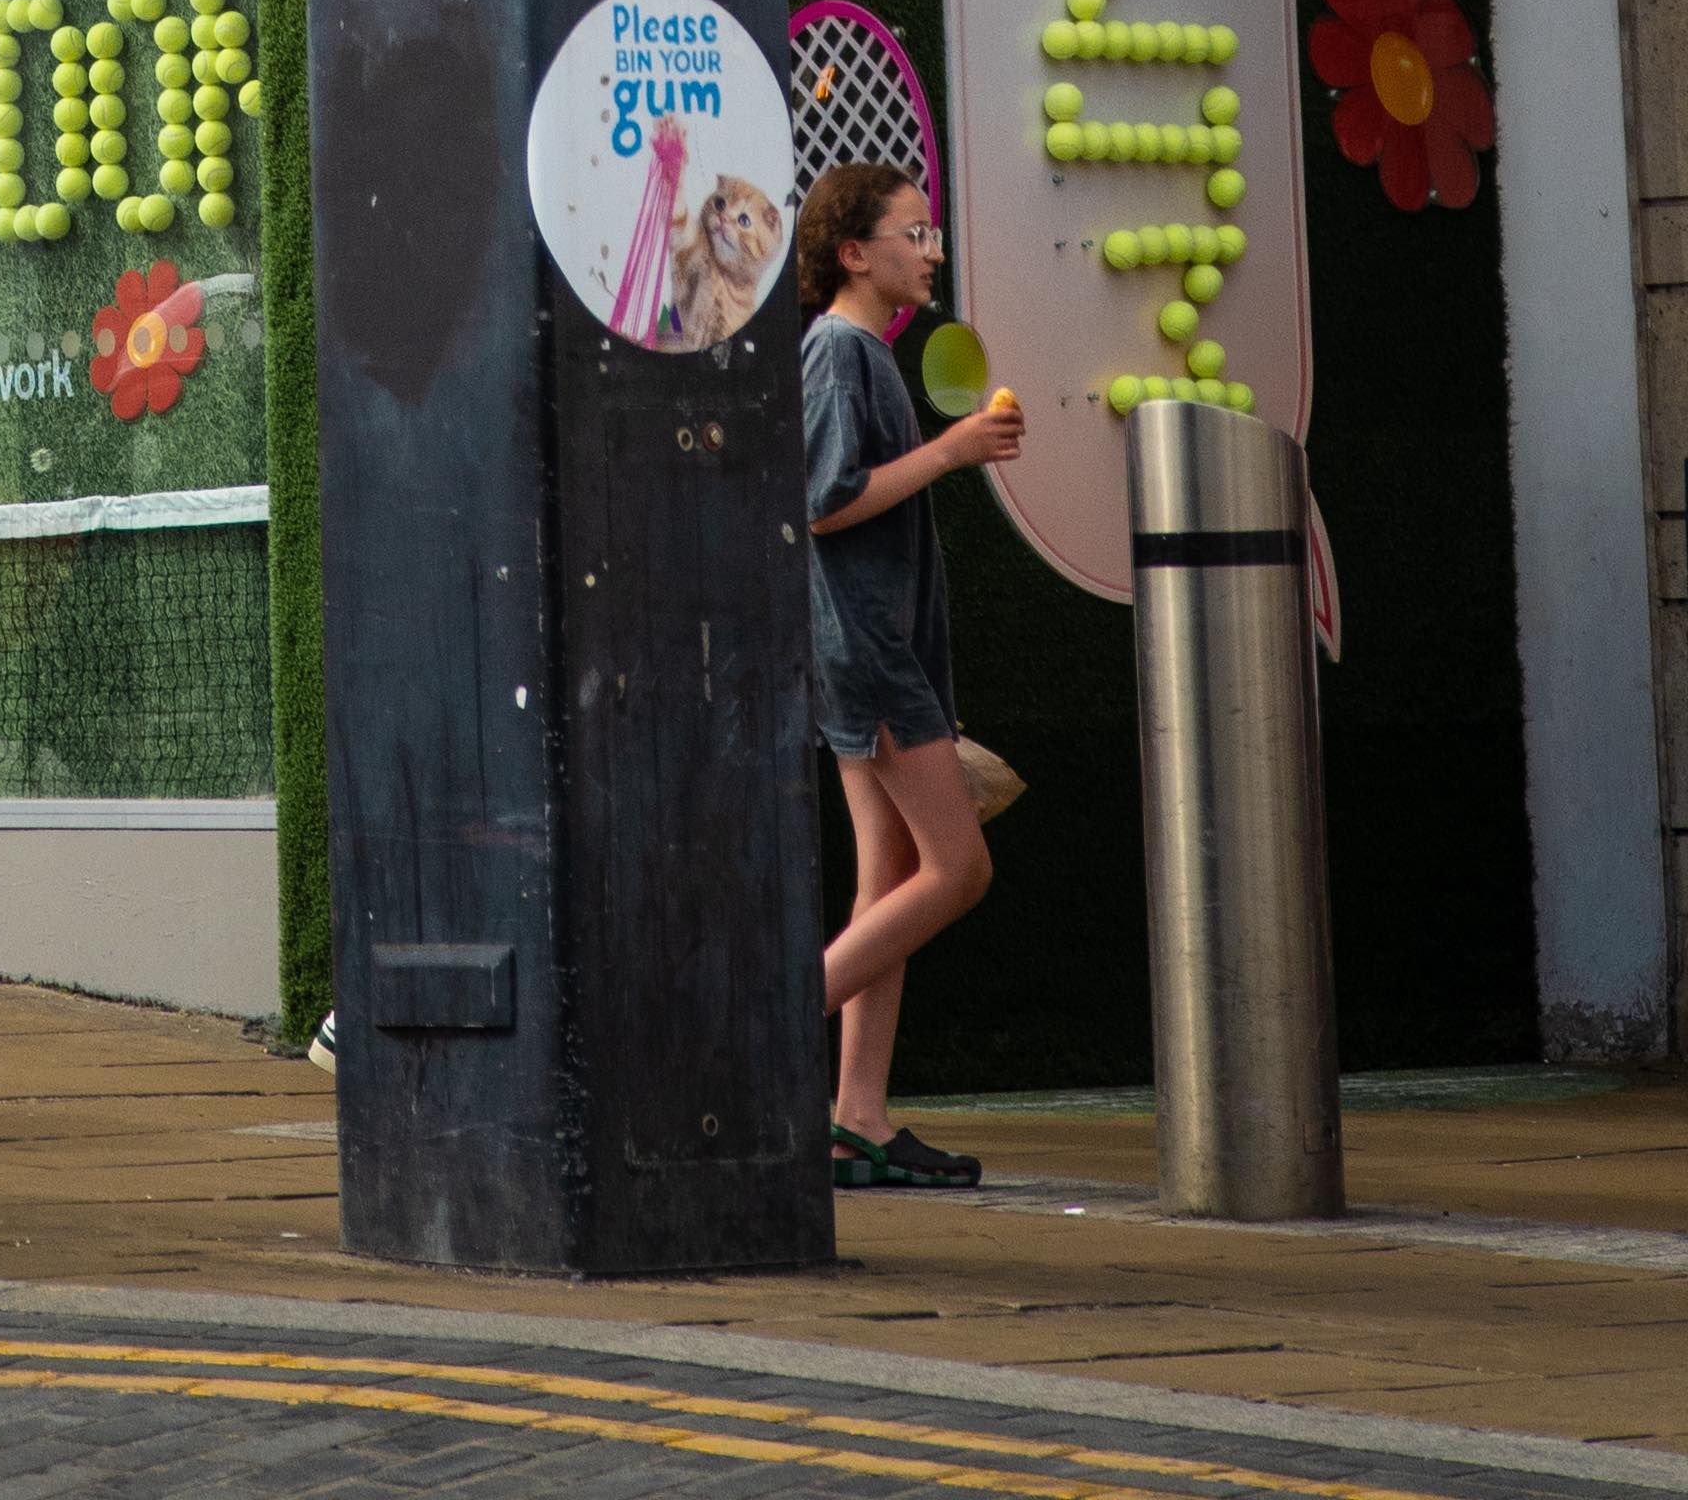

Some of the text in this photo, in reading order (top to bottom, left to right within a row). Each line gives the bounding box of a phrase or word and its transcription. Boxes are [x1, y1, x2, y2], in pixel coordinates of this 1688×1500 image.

[612, 4, 717, 43] Please
[615, 49, 722, 74] BIN YOUR
[611, 79, 721, 158] gum
